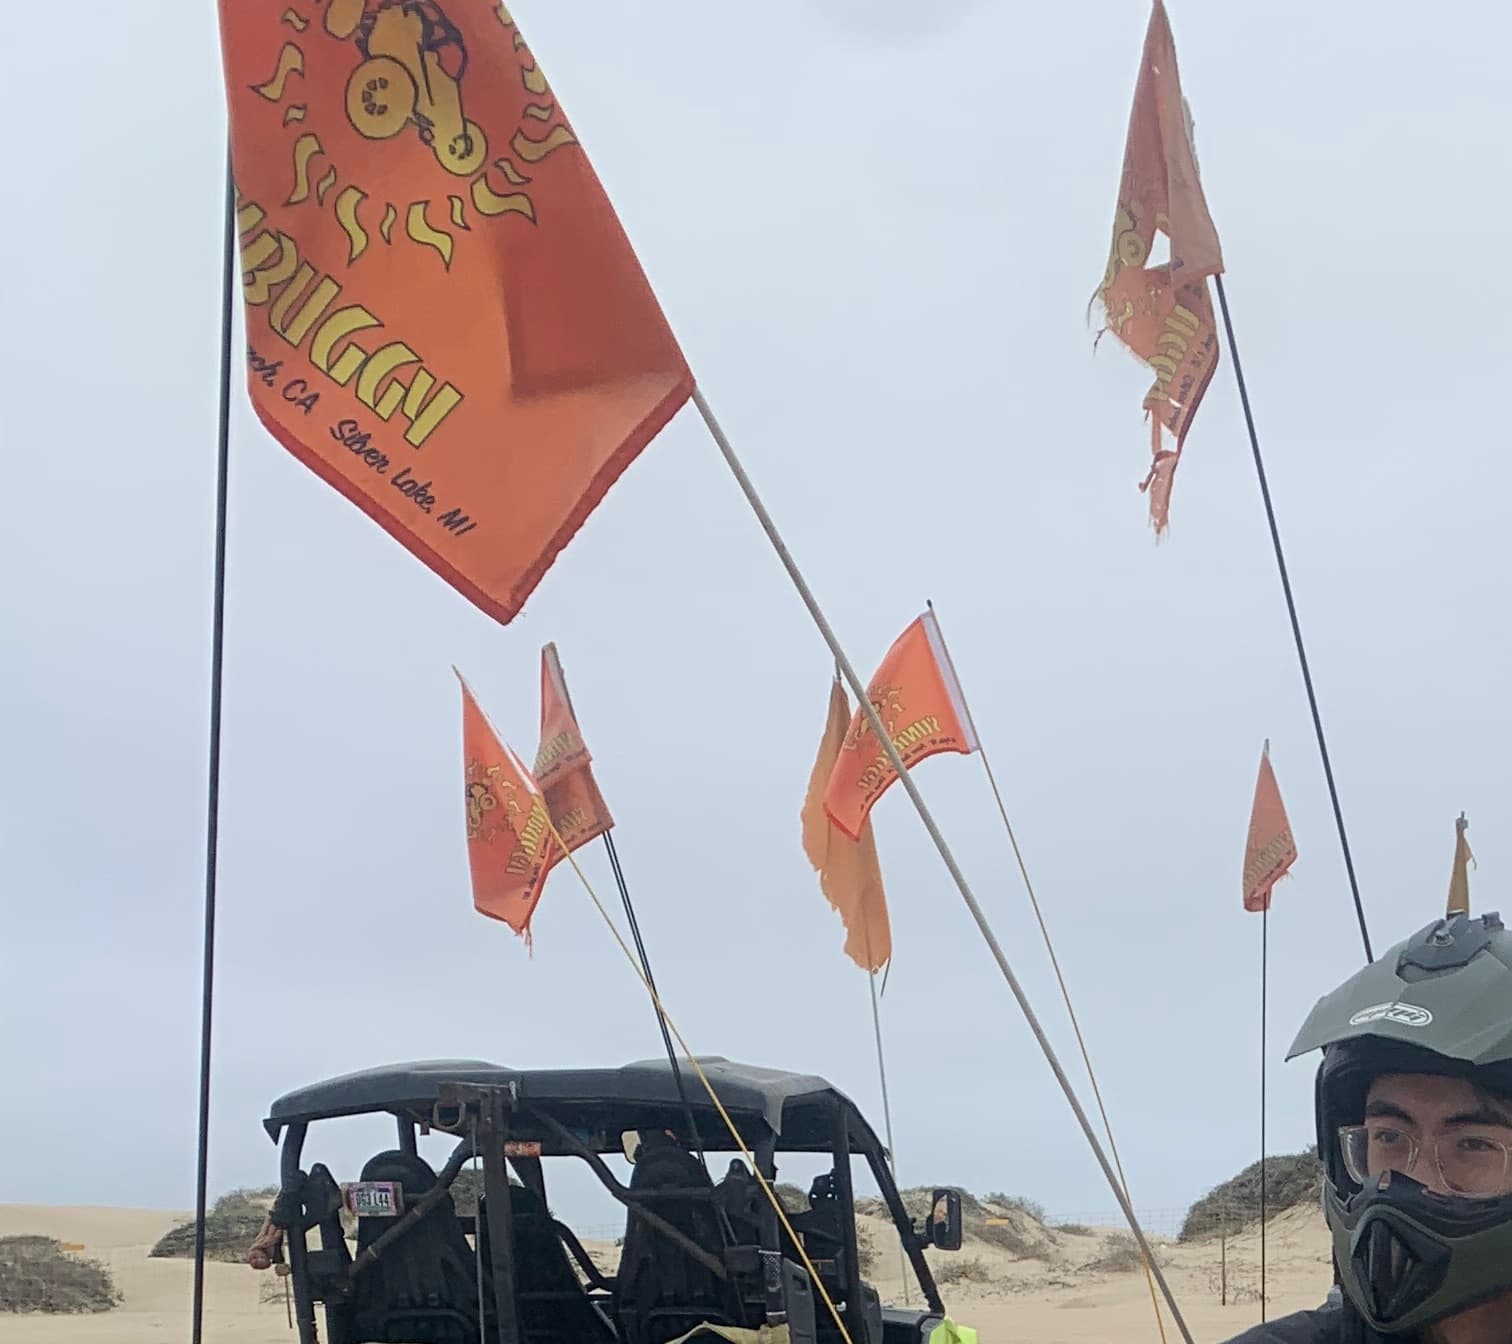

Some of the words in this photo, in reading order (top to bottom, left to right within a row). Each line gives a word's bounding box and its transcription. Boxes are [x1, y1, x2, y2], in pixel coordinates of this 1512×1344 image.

[282, 378, 320, 414] CA
[329, 418, 389, 474] Silver
[437, 508, 477, 537] MI
